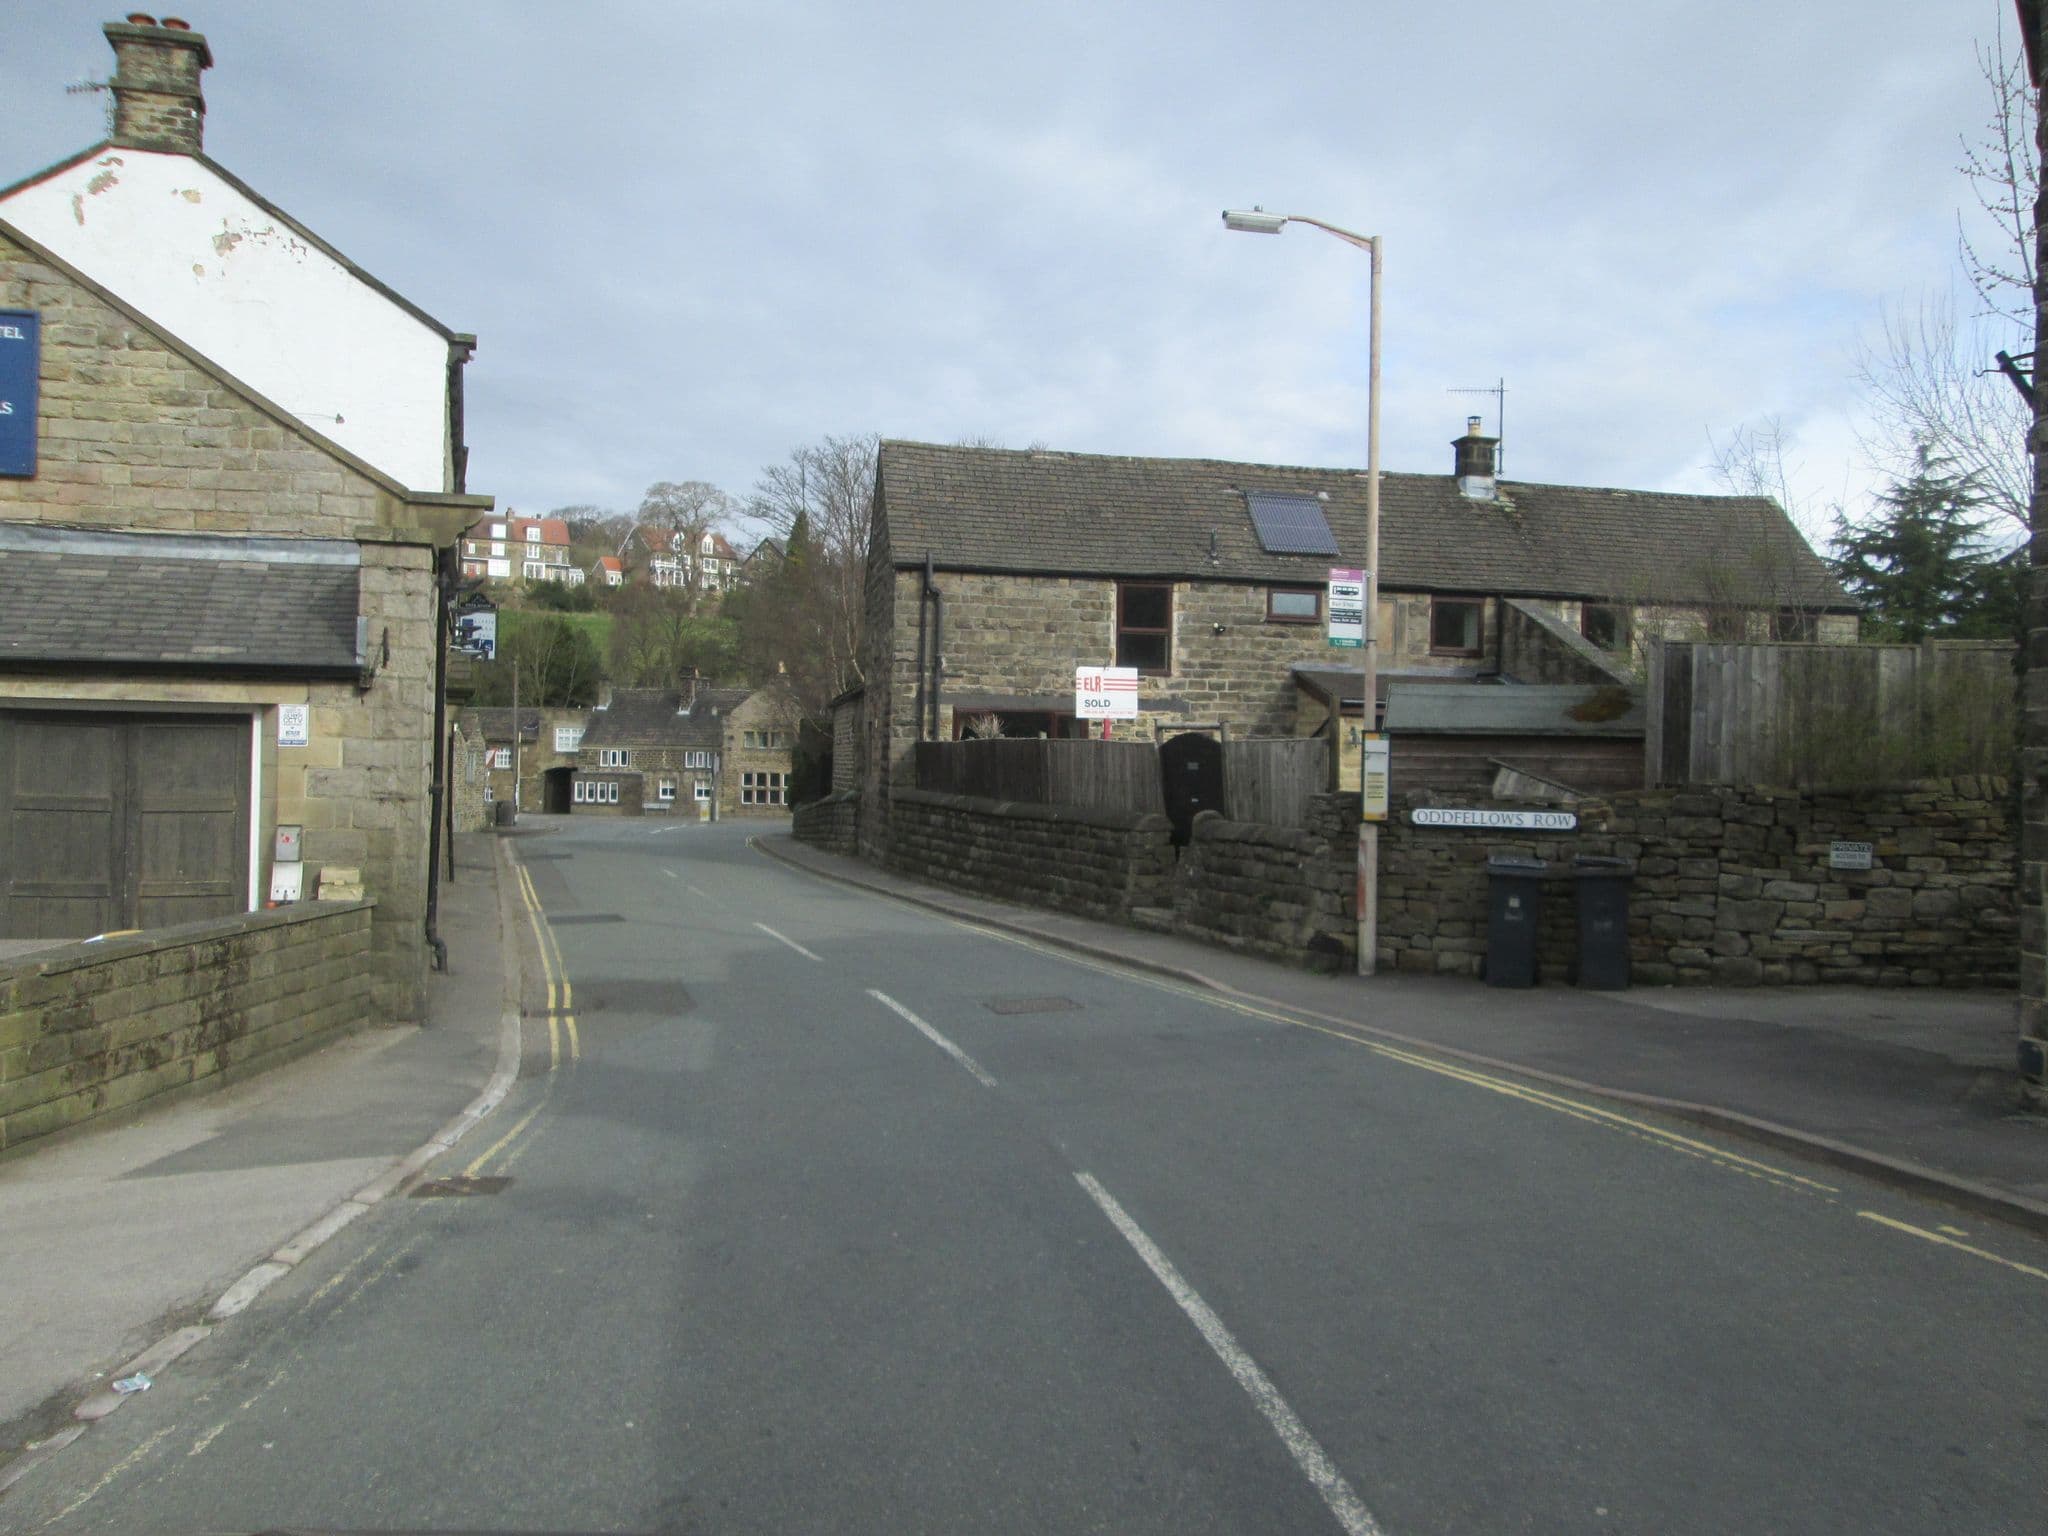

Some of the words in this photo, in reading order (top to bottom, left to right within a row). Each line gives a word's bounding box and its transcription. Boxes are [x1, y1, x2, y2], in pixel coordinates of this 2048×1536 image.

[1084, 676, 1102, 692] ELR
[1084, 699, 1110, 708] SOLD
[1417, 810, 1525, 826] ODDFELLOWS
[1534, 813, 1571, 827] ROW
